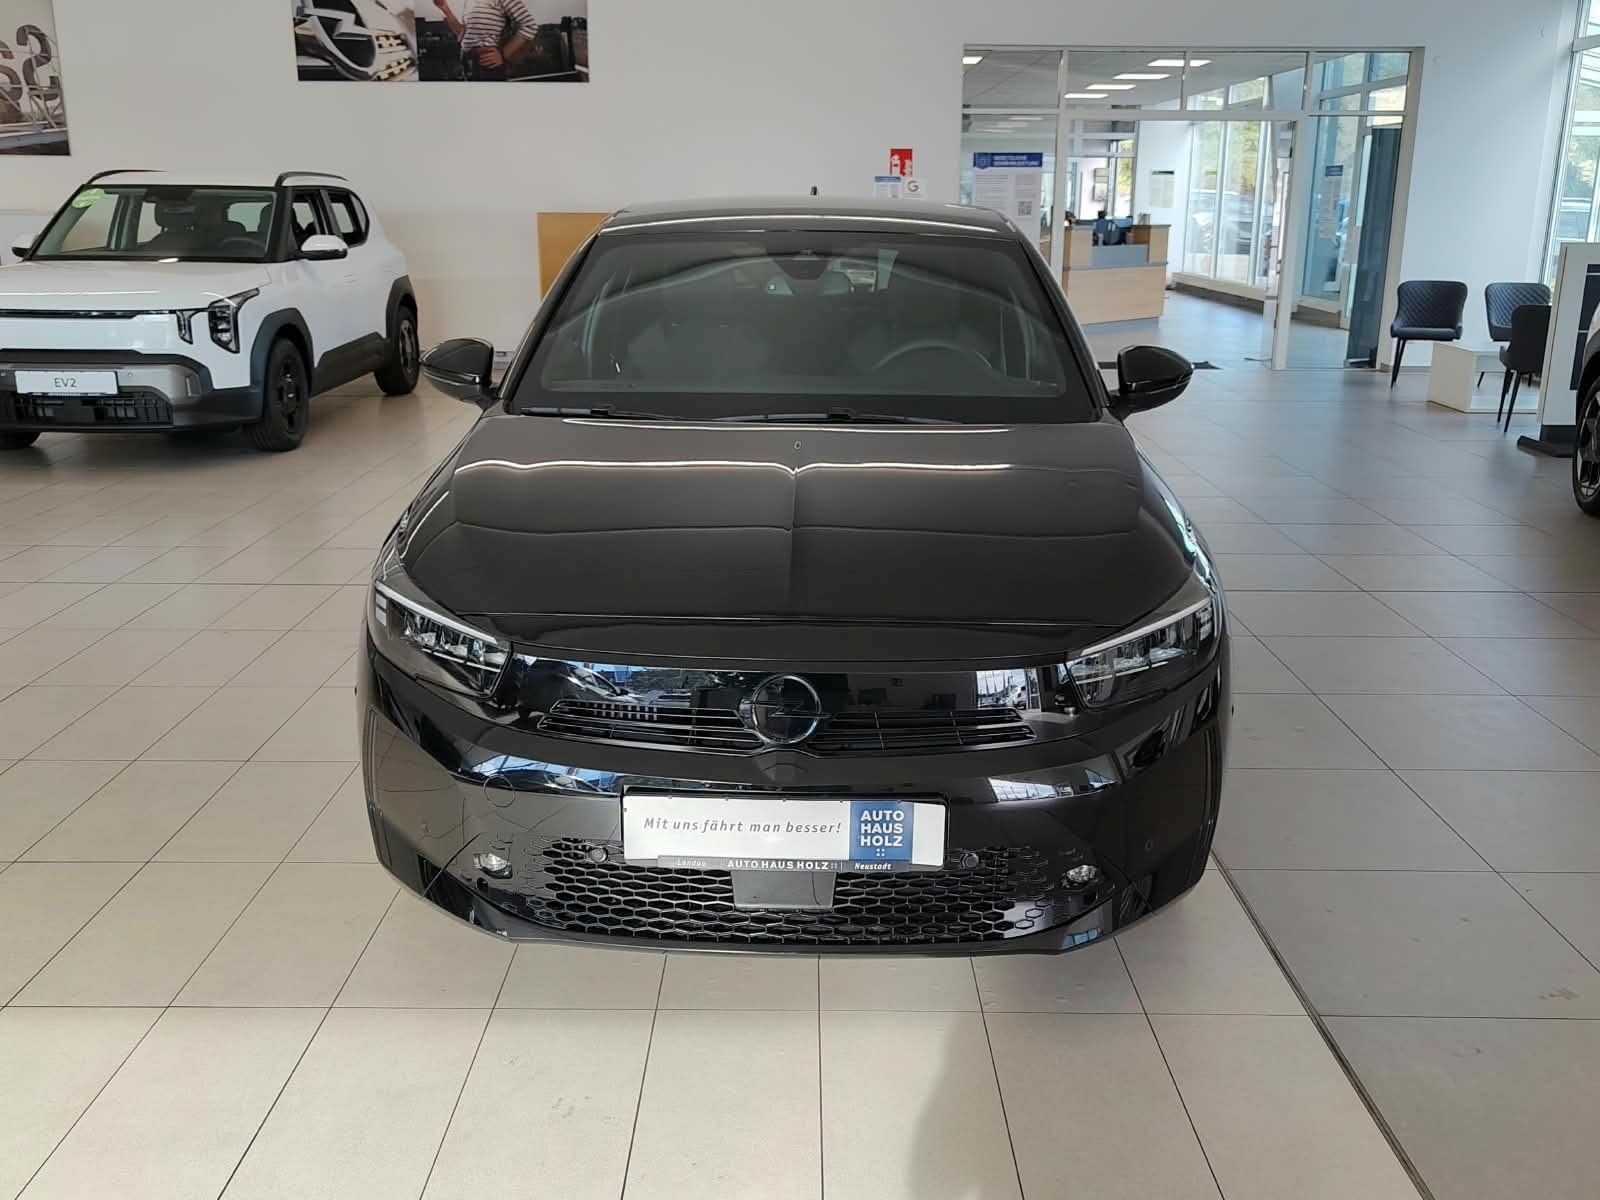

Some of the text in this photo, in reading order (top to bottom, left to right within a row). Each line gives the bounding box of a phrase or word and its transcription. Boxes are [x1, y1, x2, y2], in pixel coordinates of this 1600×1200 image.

[54, 378, 77, 388] EV2
[861, 810, 905, 821] AUTO
[644, 818, 841, 833] Mit uns fährt man besser!
[860, 823, 904, 834] HAUS
[860, 835, 903, 847] HOLZ
[854, 863, 892, 871] Neustadt
